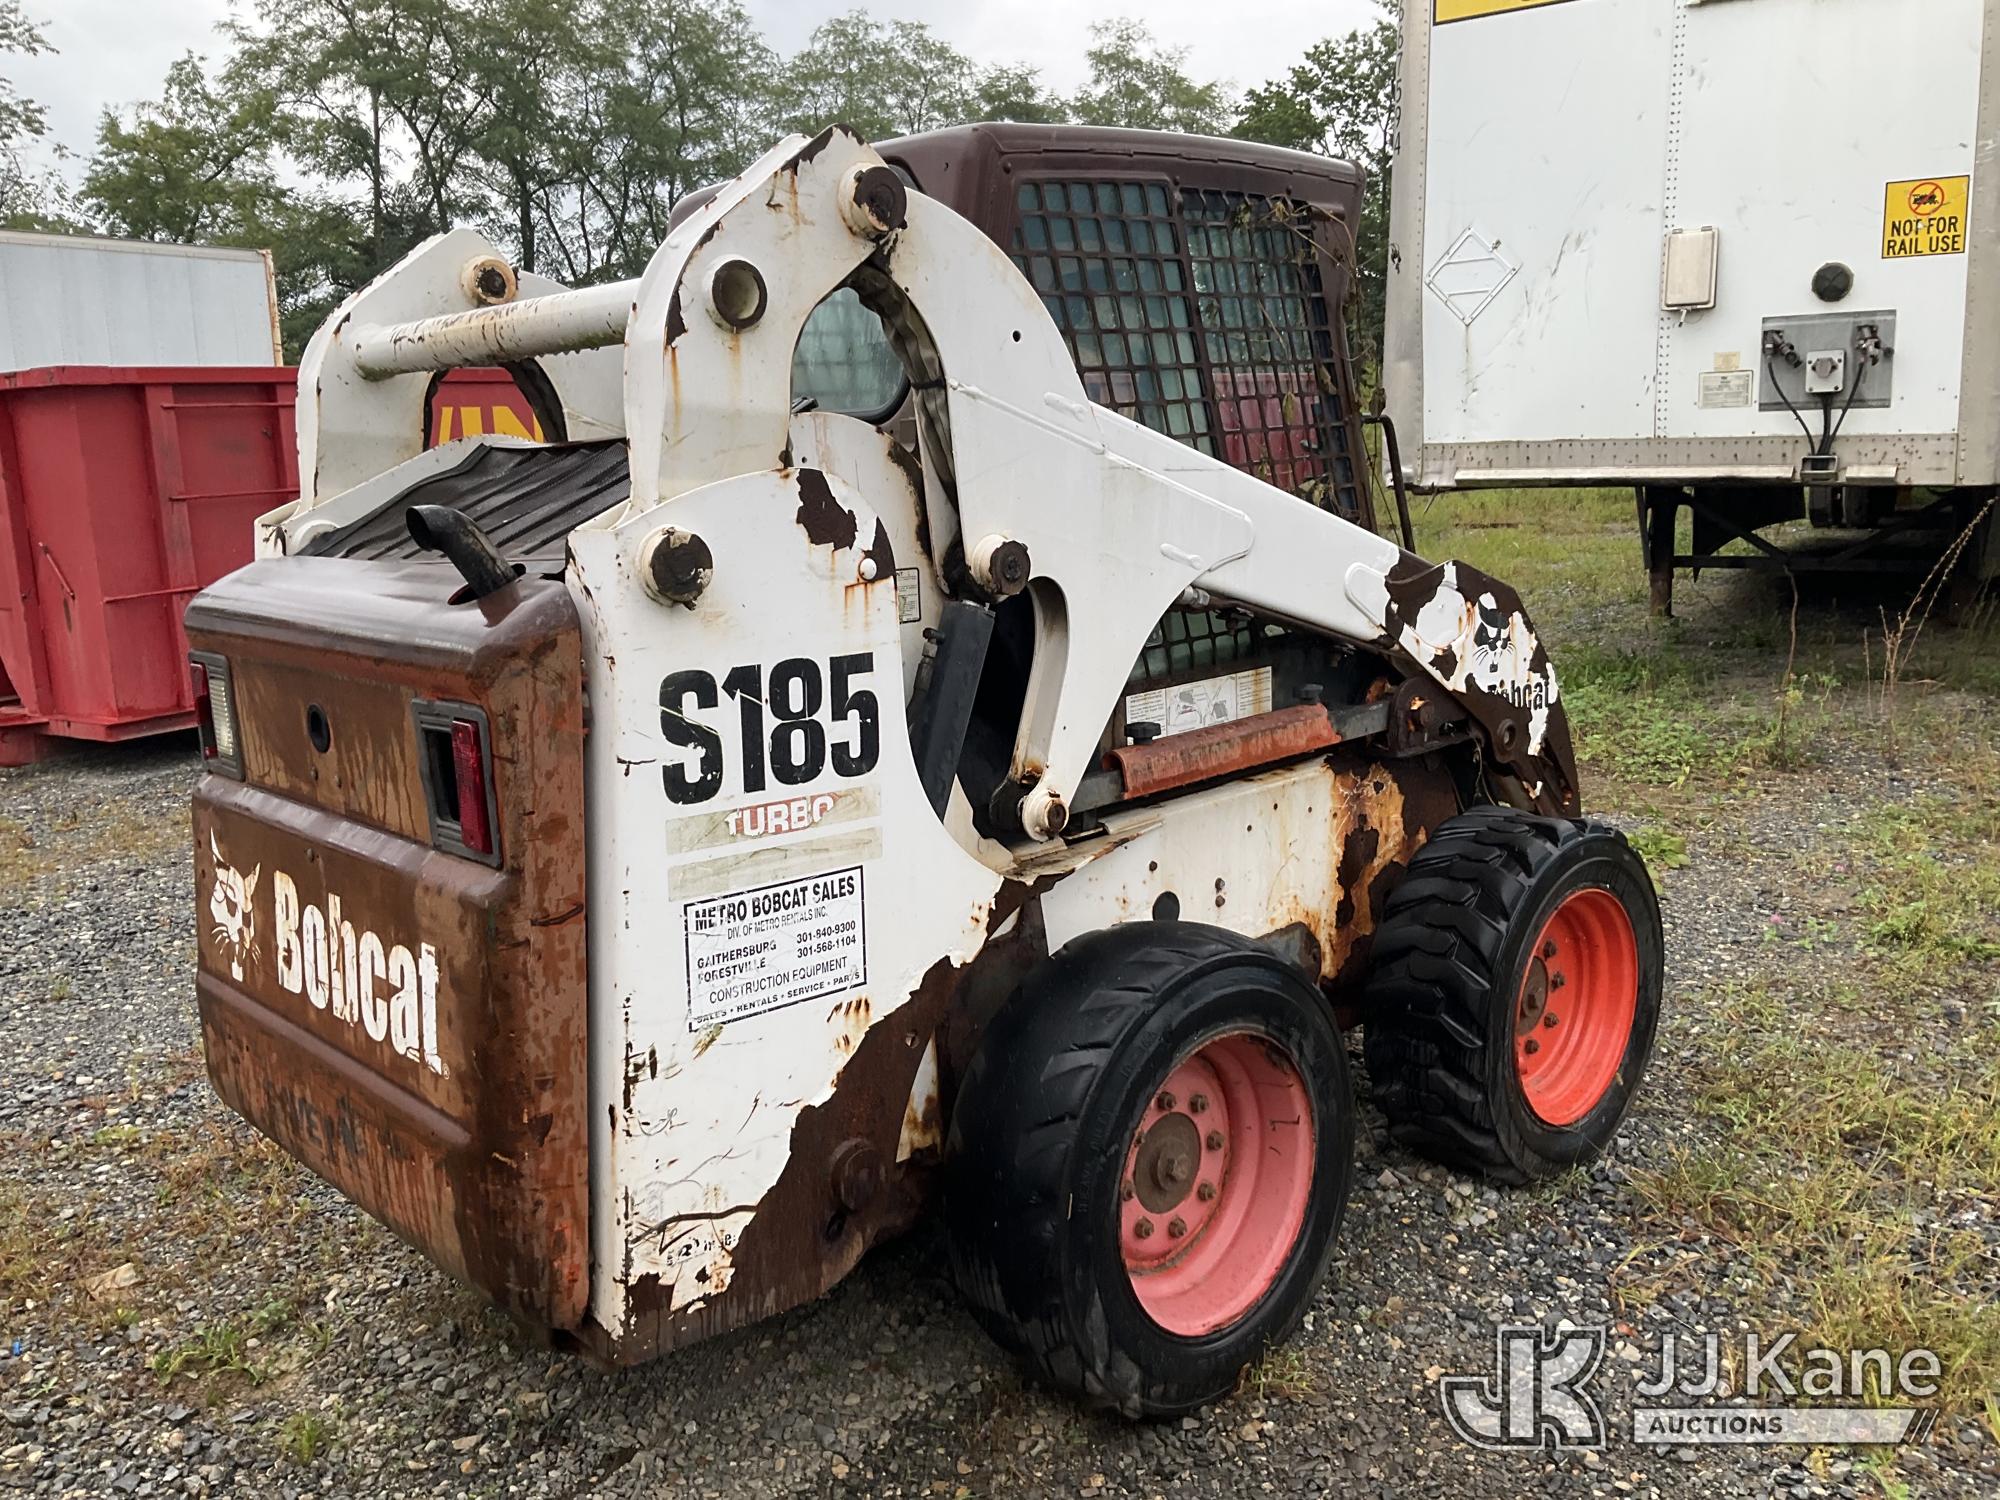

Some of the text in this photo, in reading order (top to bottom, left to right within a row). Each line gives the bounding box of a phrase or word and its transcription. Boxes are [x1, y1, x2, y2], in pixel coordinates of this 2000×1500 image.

[1891, 216, 1958, 237] NOT FOR
[1886, 235, 1961, 256] RAIL USE
[659, 652, 880, 805] S185
[695, 875, 855, 931] METRO BOBCAT SALES
[727, 905, 828, 940] DIV. OF METRO RENTALS INC.
[796, 920, 856, 944] 301-840-9300
[697, 940, 777, 969] GAITHERSBURG
[273, 870, 443, 1075] Bobcat
[709, 955, 849, 1004] CONSTRUCTION EQUIPMENT
[737, 996, 778, 1013] RENTALS
[787, 981, 825, 998] SERVICE
